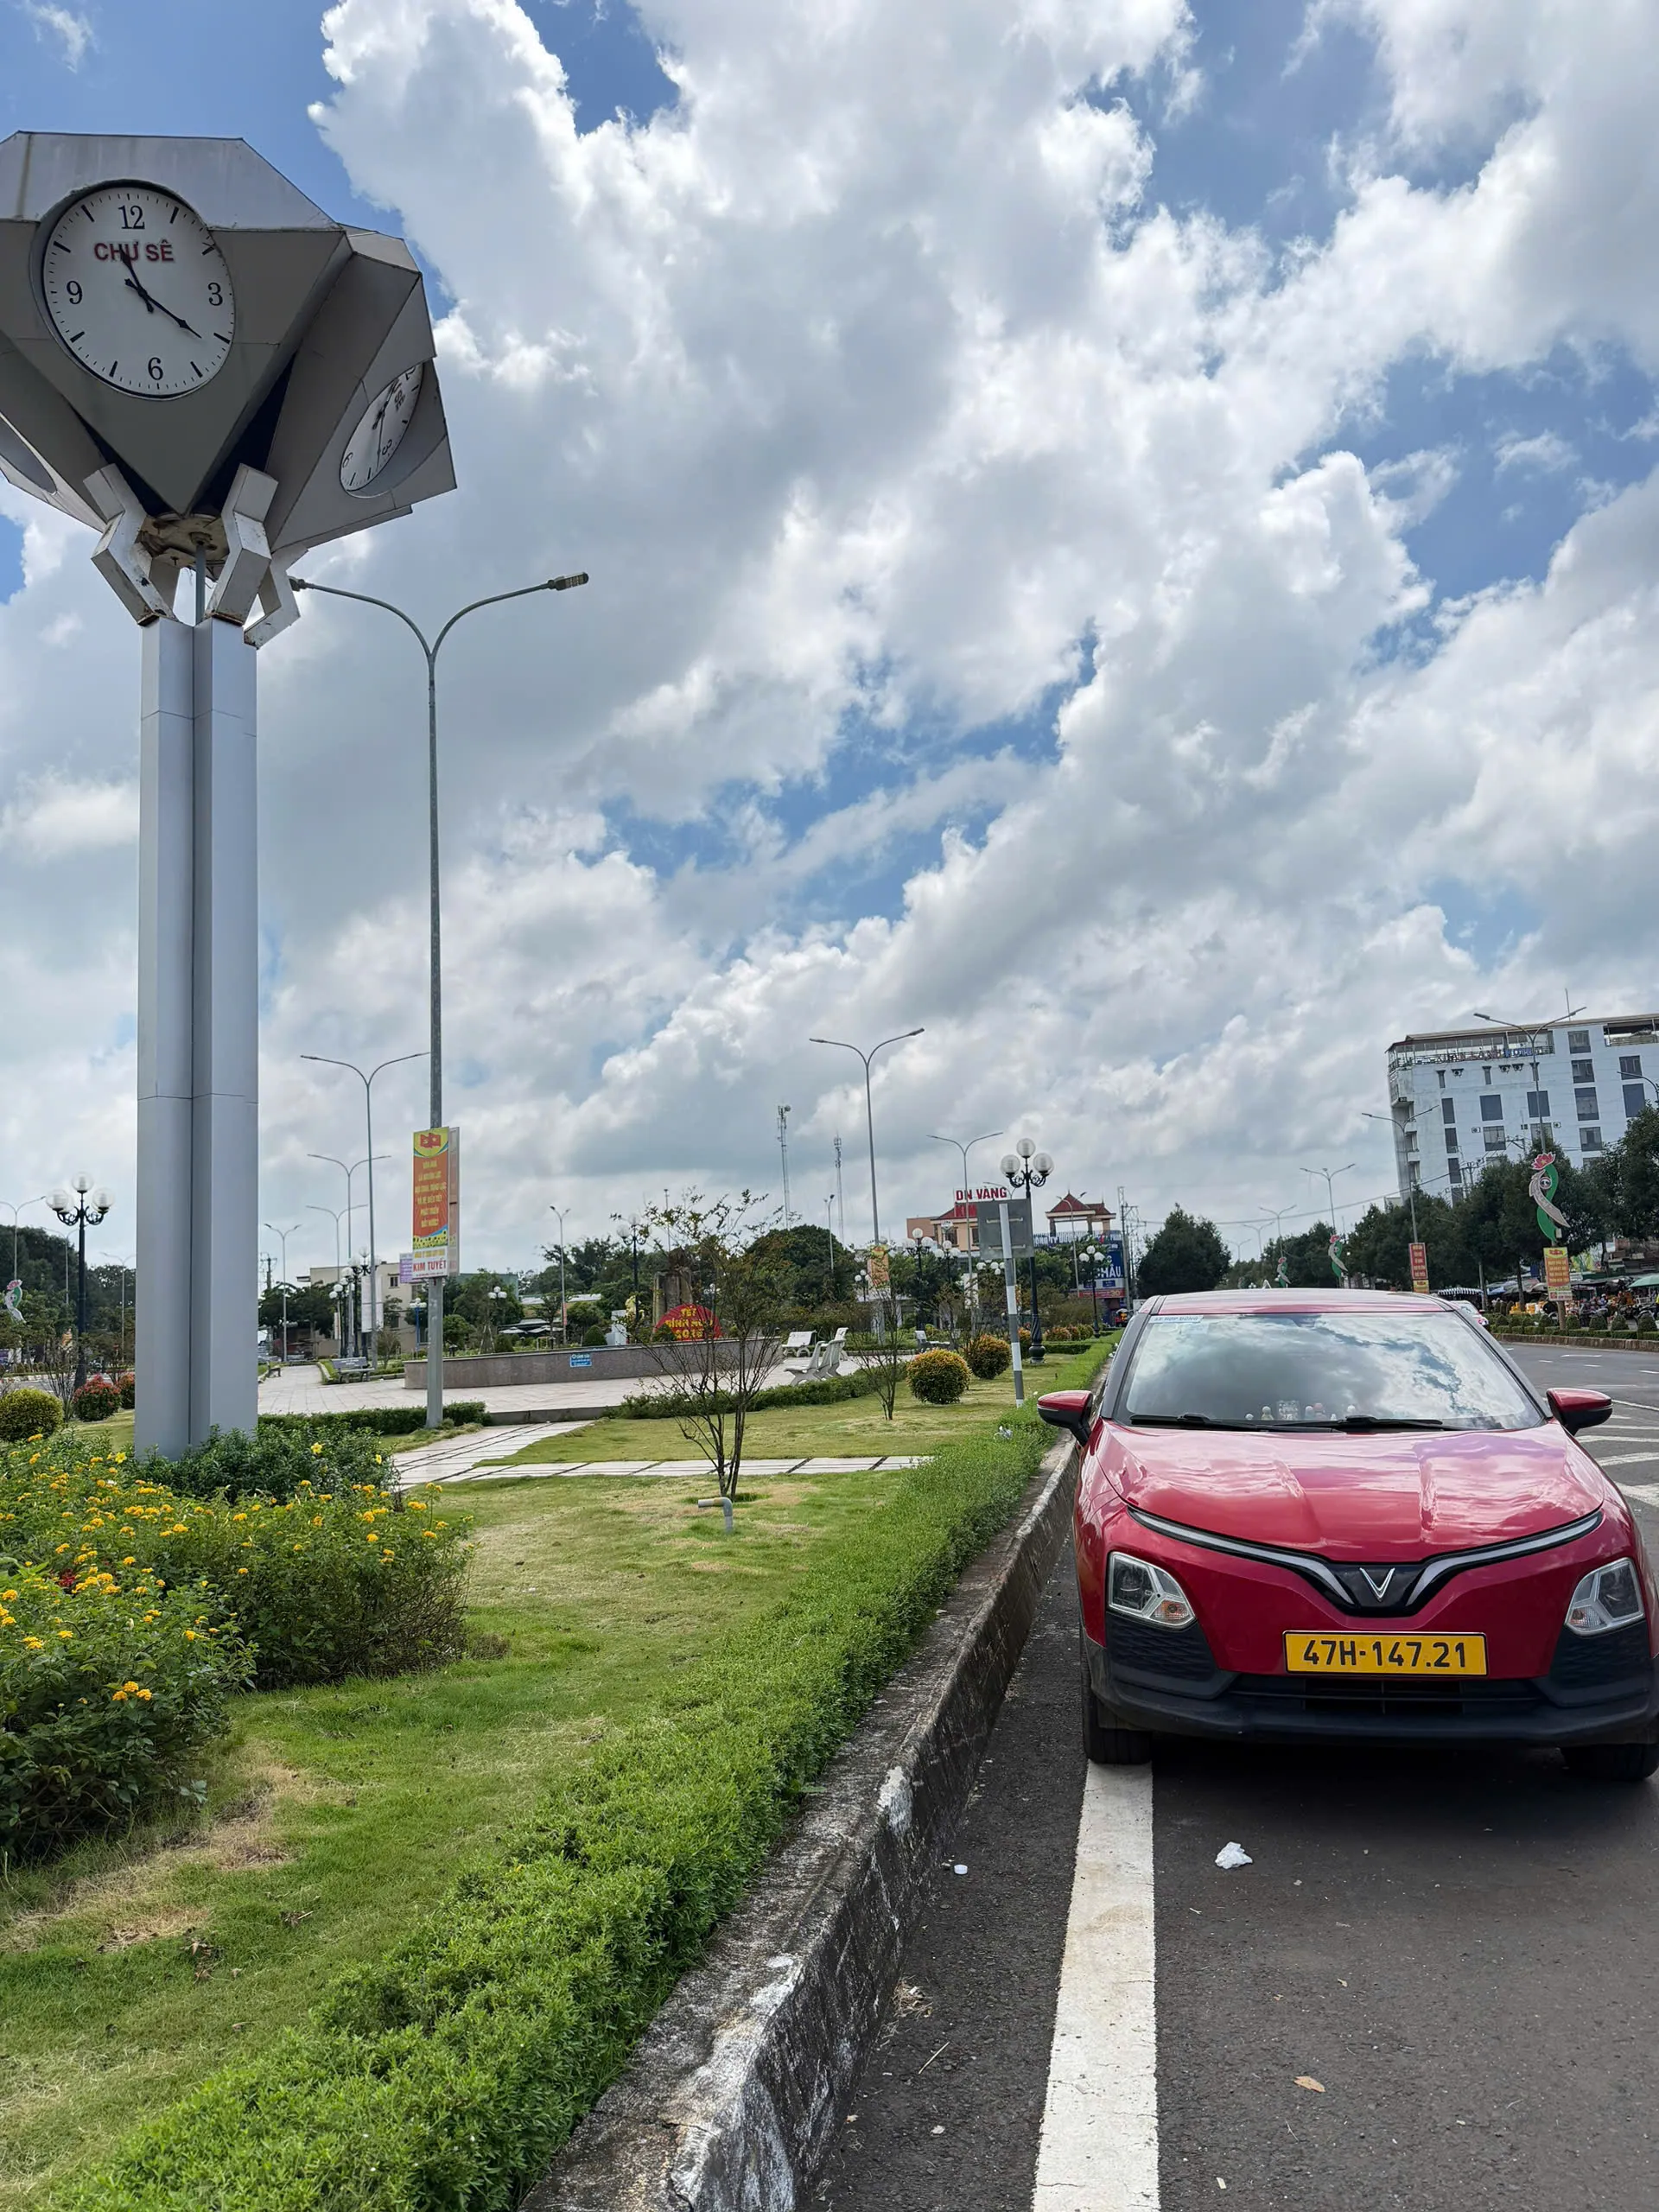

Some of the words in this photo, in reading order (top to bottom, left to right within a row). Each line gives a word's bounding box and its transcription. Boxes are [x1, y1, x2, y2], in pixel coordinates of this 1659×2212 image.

[118, 205, 145, 230] 12
[94, 241, 139, 261] CHƯ
[146, 239, 175, 262] SÊ
[67, 280, 83, 305] 9
[207, 283, 224, 307] 3
[148, 357, 164, 380] 6
[382, 439, 392, 456] 3
[413, 1262, 426, 1272] KIM
[428, 1257, 447, 1270] TUYẾT
[1303, 1639, 1465, 1668] 47H-147.21
